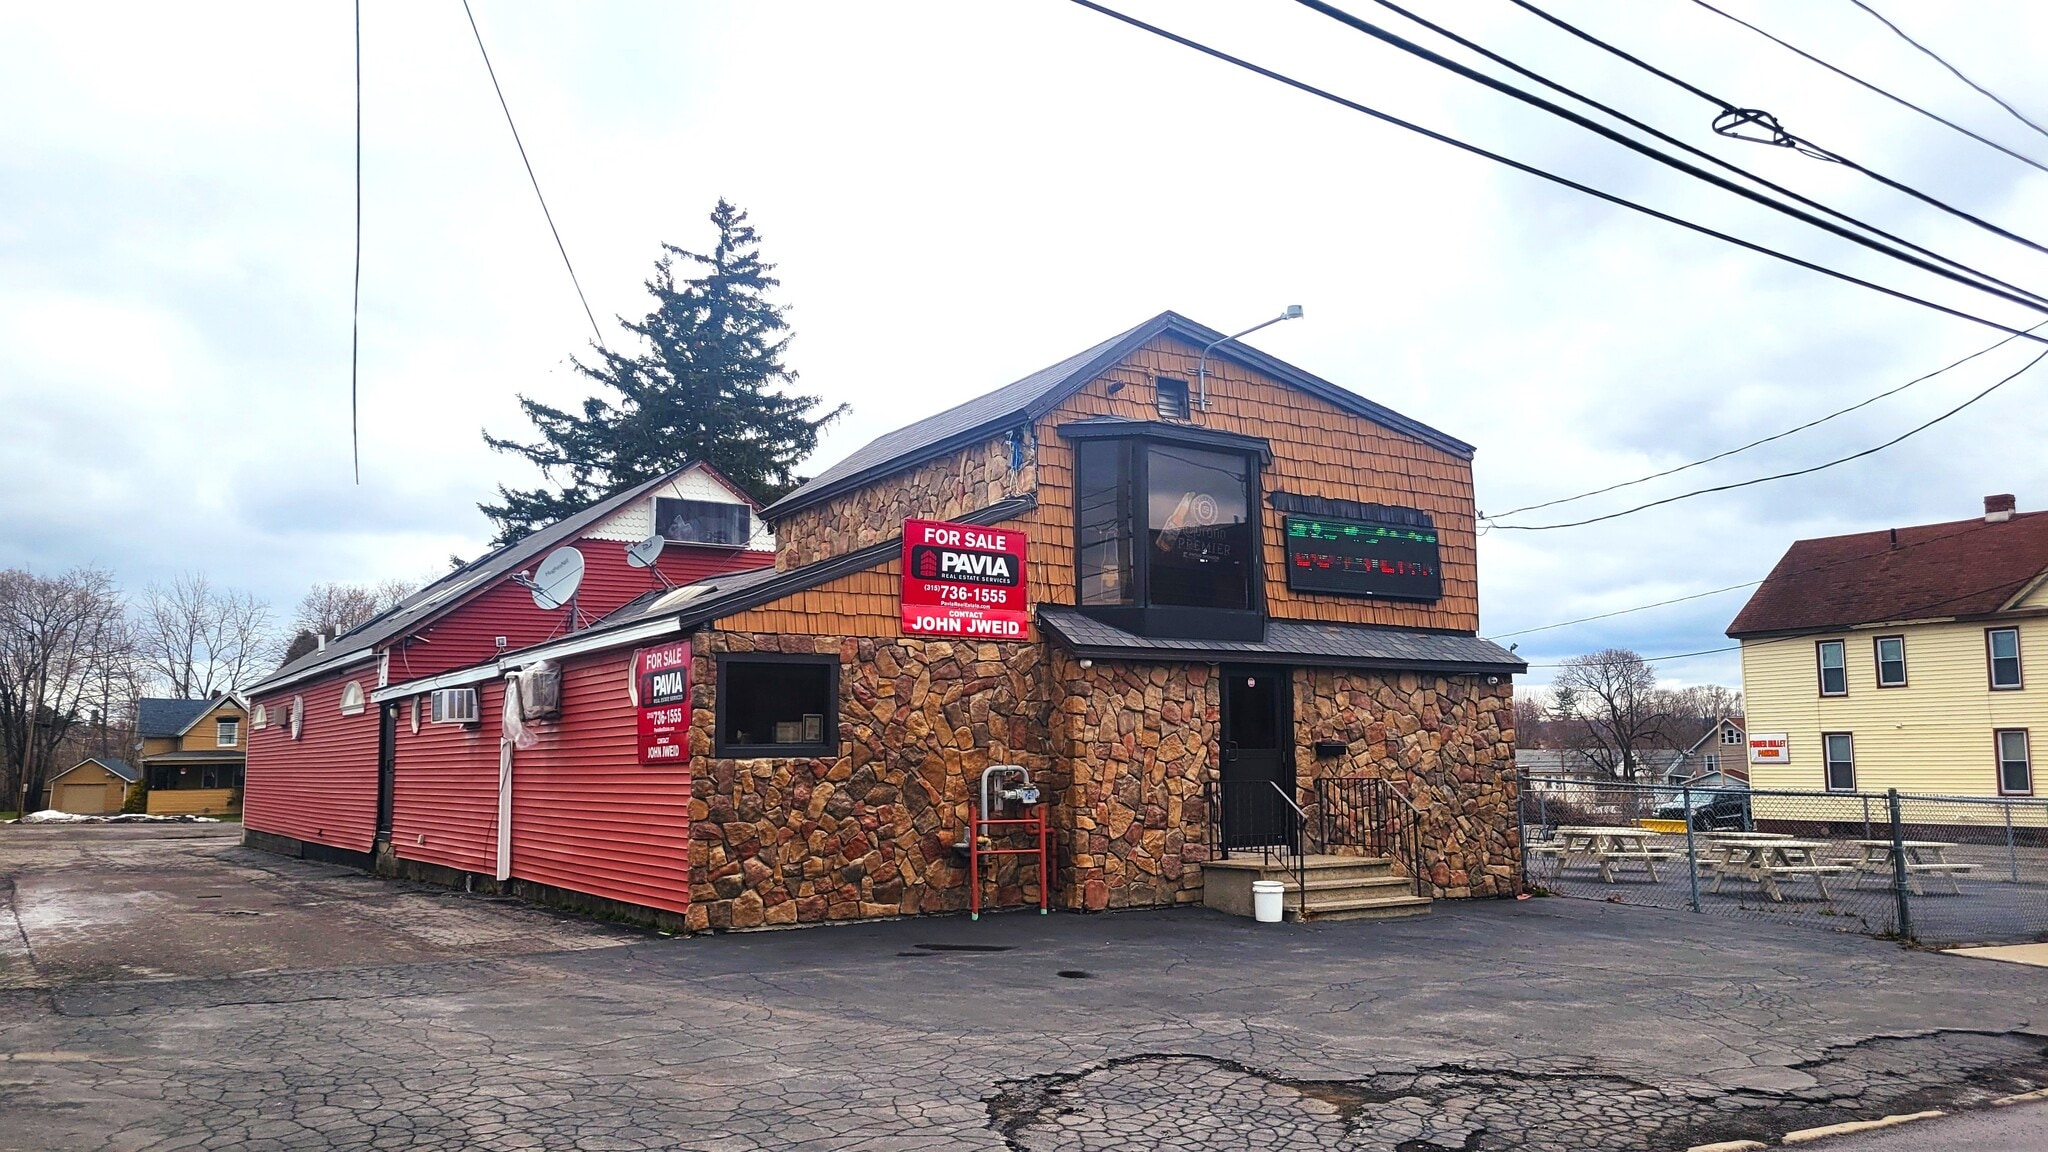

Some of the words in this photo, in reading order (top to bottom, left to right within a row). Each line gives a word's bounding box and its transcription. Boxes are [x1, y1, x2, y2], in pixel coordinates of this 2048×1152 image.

[924, 527, 960, 546] FOR
[964, 532, 1006, 550] SALE
[1178, 538, 1231, 556] PREMIER
[941, 552, 1010, 577] PAVIA
[981, 576, 1011, 584] SERVICES
[949, 610, 983, 619] CONTACT
[911, 616, 961, 632] JOHN
[966, 619, 1020, 635] JWEID
[646, 652, 662, 670] FOR
[663, 648, 682, 667] SALE
[653, 671, 682, 696] PAVIA
[647, 746, 661, 759] JOHN
